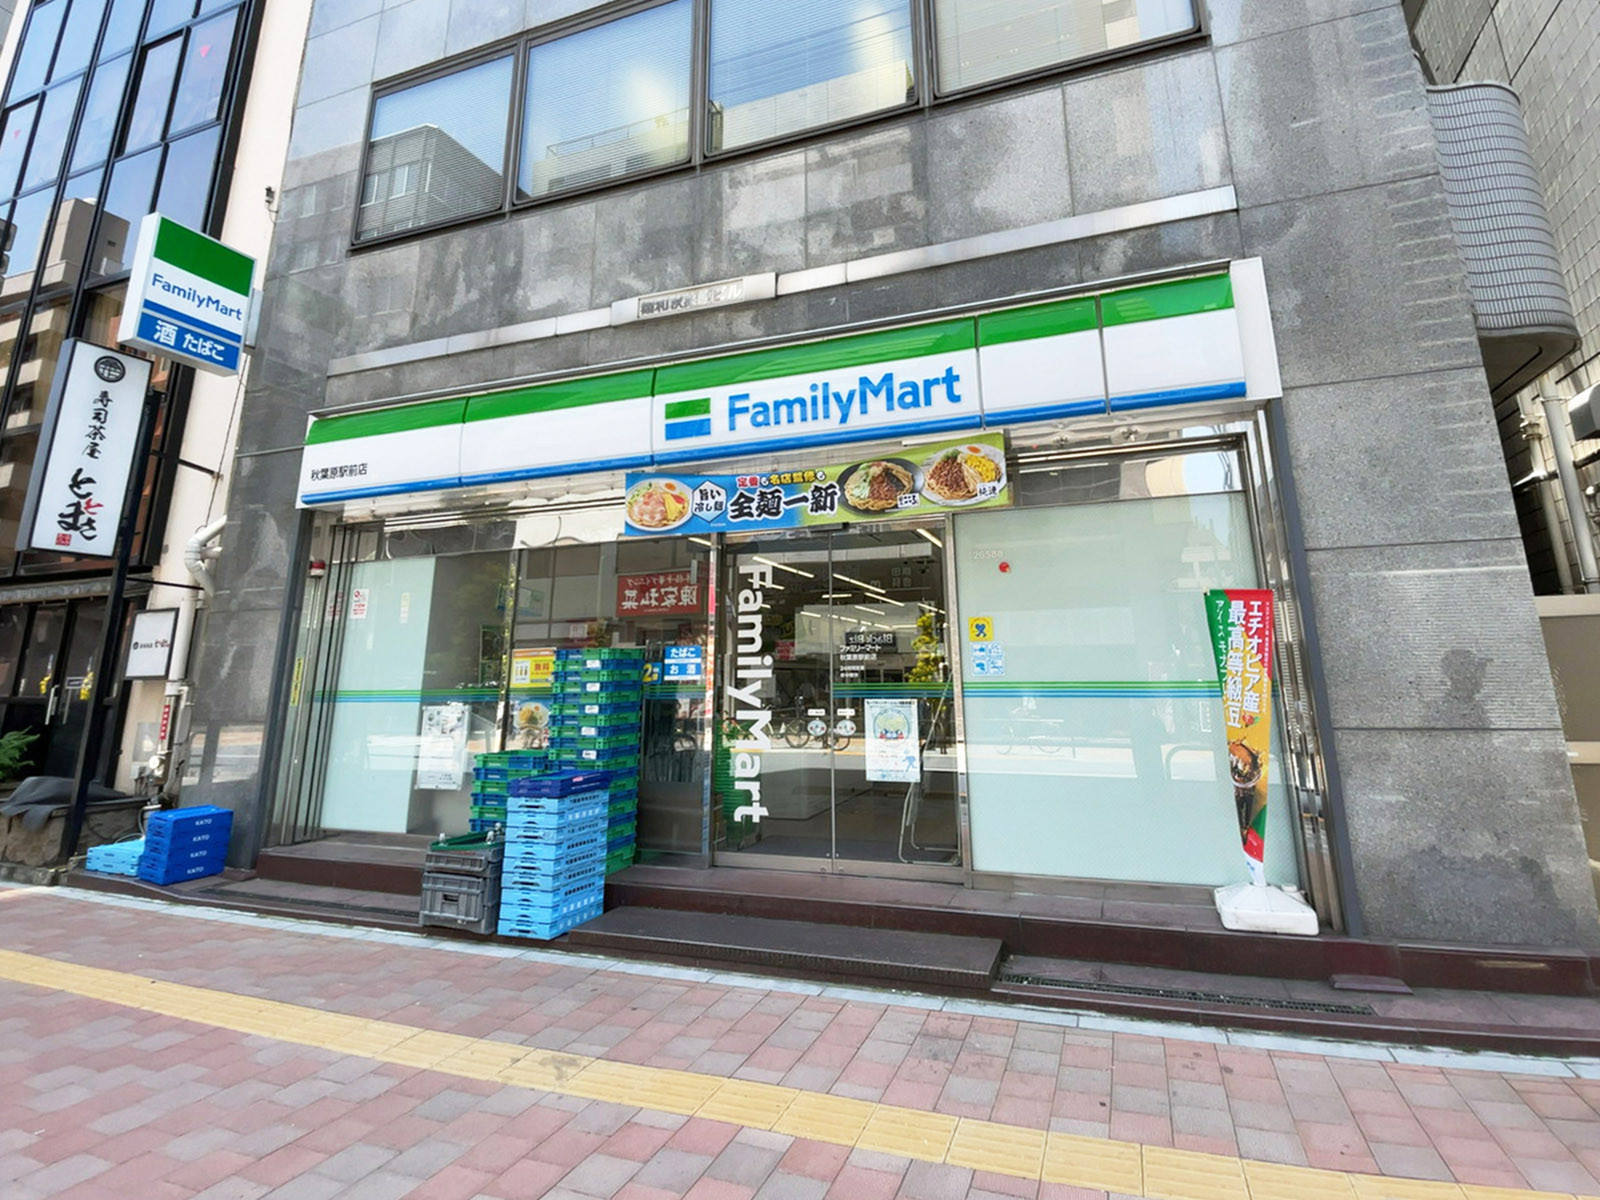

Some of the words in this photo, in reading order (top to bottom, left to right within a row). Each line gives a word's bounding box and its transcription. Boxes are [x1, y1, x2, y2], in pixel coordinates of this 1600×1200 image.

[151, 273, 242, 321] FamilyMart
[154, 320, 178, 346] 酒
[183, 332, 225, 361] たばこ
[728, 366, 961, 431] FamilyMart
[311, 463, 368, 480] 秋葉原駅前店
[700, 489, 721, 500] 旨い
[729, 484, 838, 519] 全麺一新
[671, 648, 696, 658] たばこ
[840, 645, 881, 653] ファミリーマート
[1243, 601, 1264, 713] エチオピア産
[1226, 600, 1247, 728] 最高等級豆
[727, 565, 774, 823] FamilyMart
[193, 834, 210, 842] KATO
[190, 850, 207, 858] KATO
[187, 866, 204, 874] KATO
